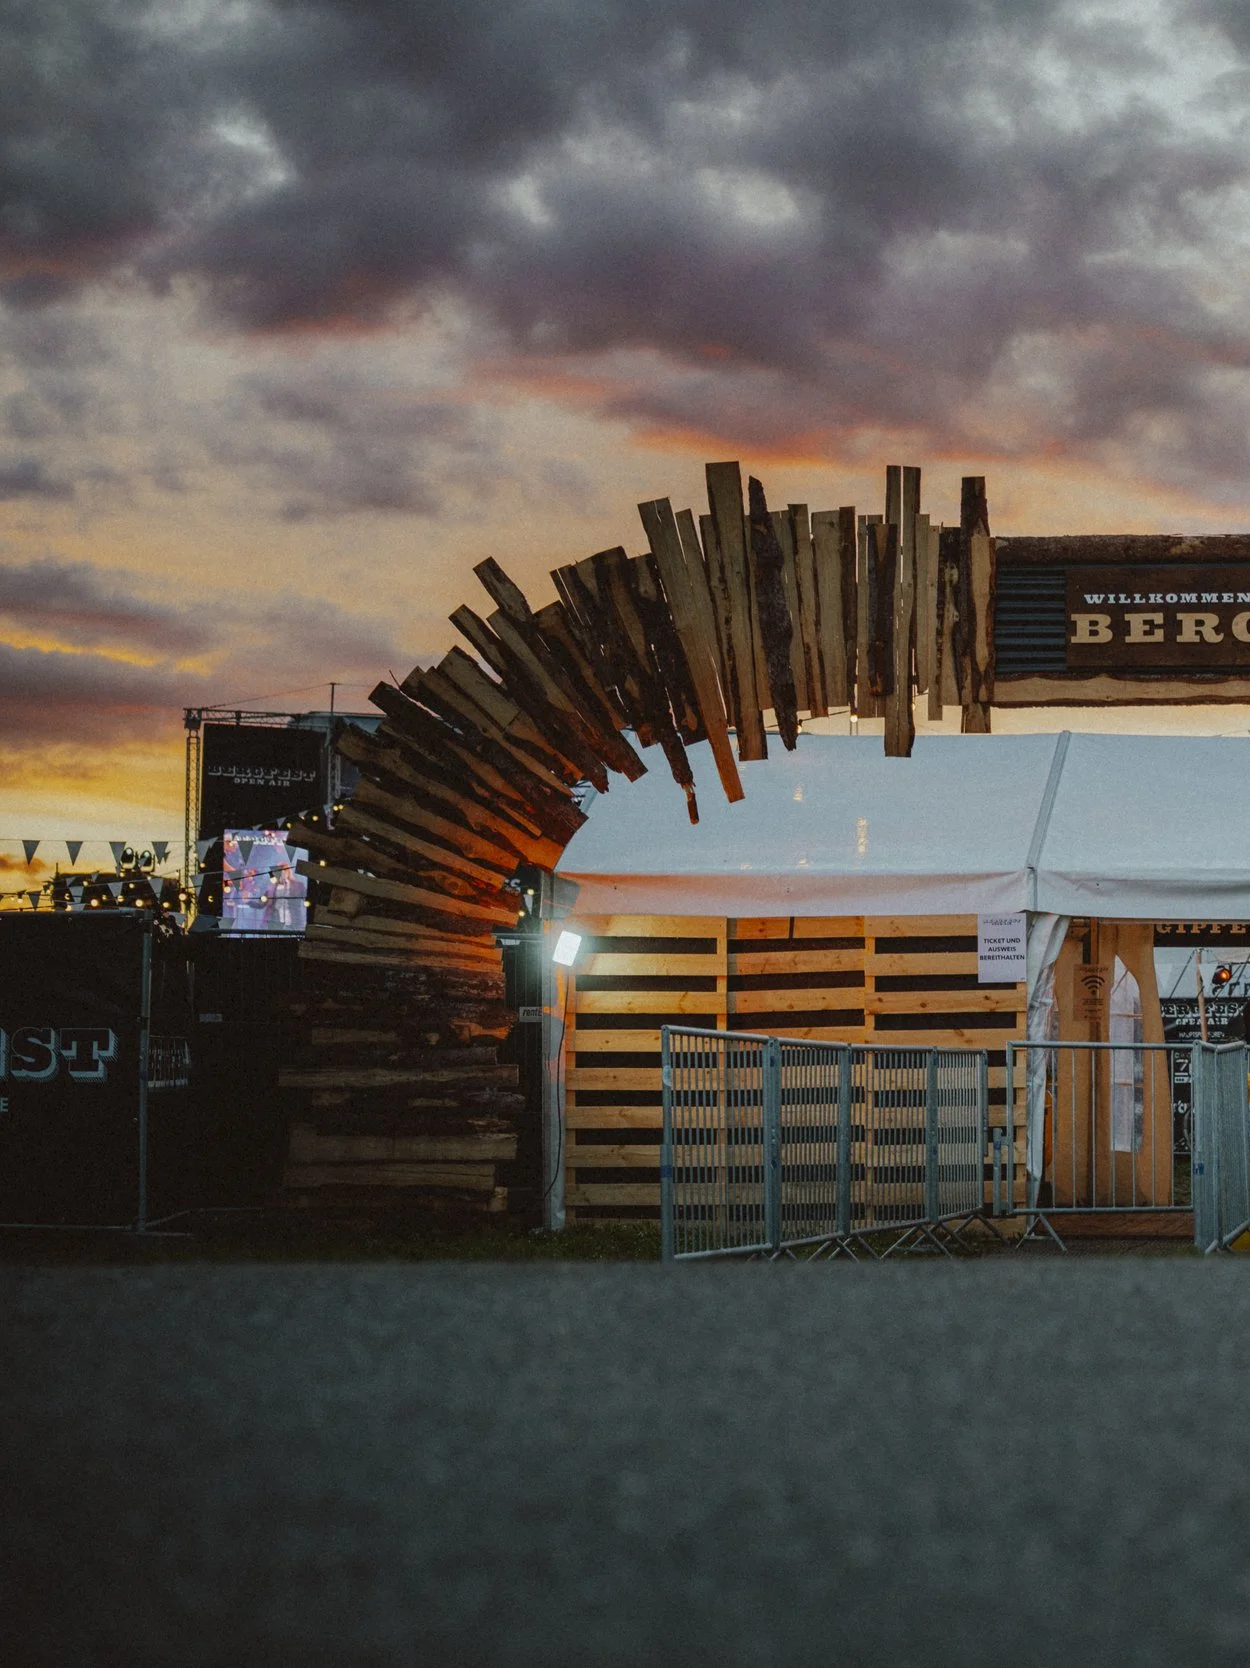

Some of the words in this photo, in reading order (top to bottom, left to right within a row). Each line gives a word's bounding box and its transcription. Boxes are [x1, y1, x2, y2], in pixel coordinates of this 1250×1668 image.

[234, 777, 265, 785] OPEN
[268, 779, 291, 787] AIR
[0, 1027, 119, 1083] ST
